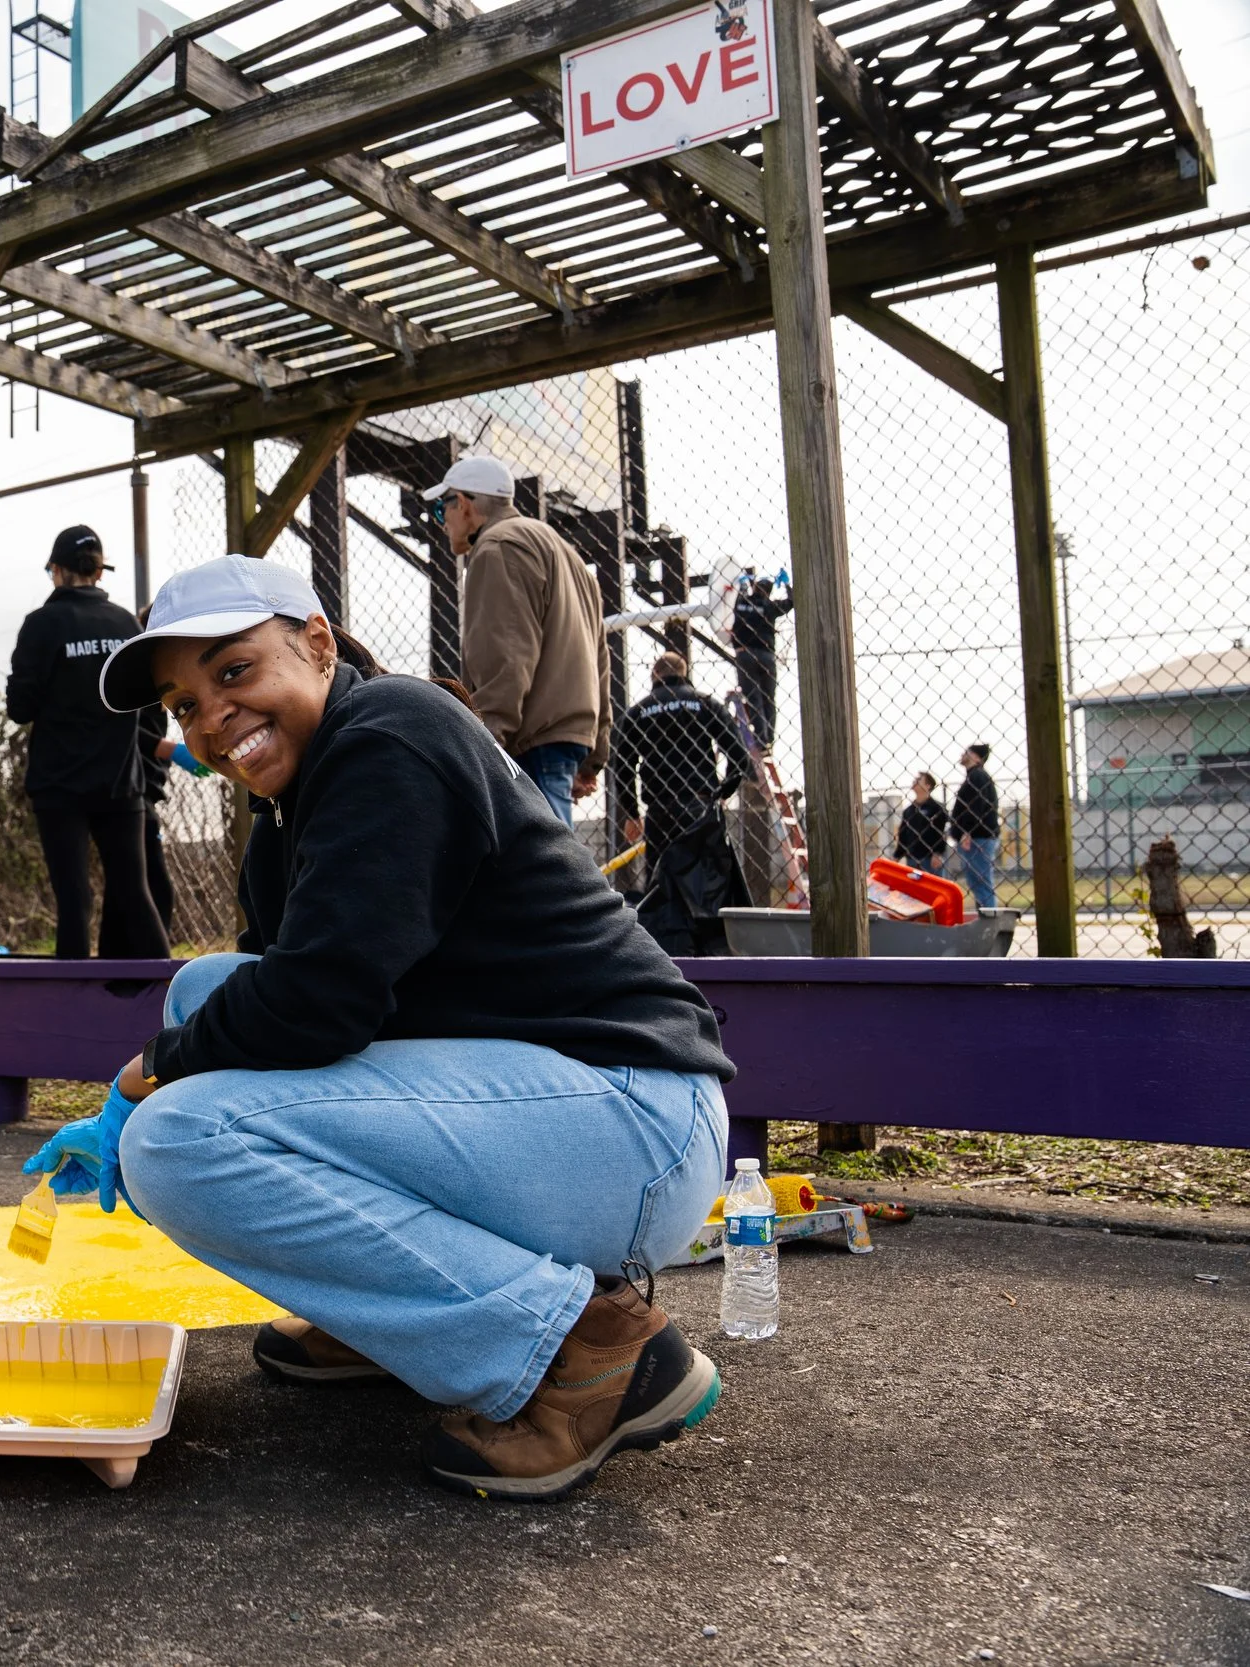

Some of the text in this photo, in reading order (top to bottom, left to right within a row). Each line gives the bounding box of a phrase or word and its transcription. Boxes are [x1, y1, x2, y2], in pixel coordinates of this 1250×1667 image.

[580, 35, 760, 136] LOVE
[65, 640, 99, 658] MADE
[638, 1353, 658, 1397] ARIAT
